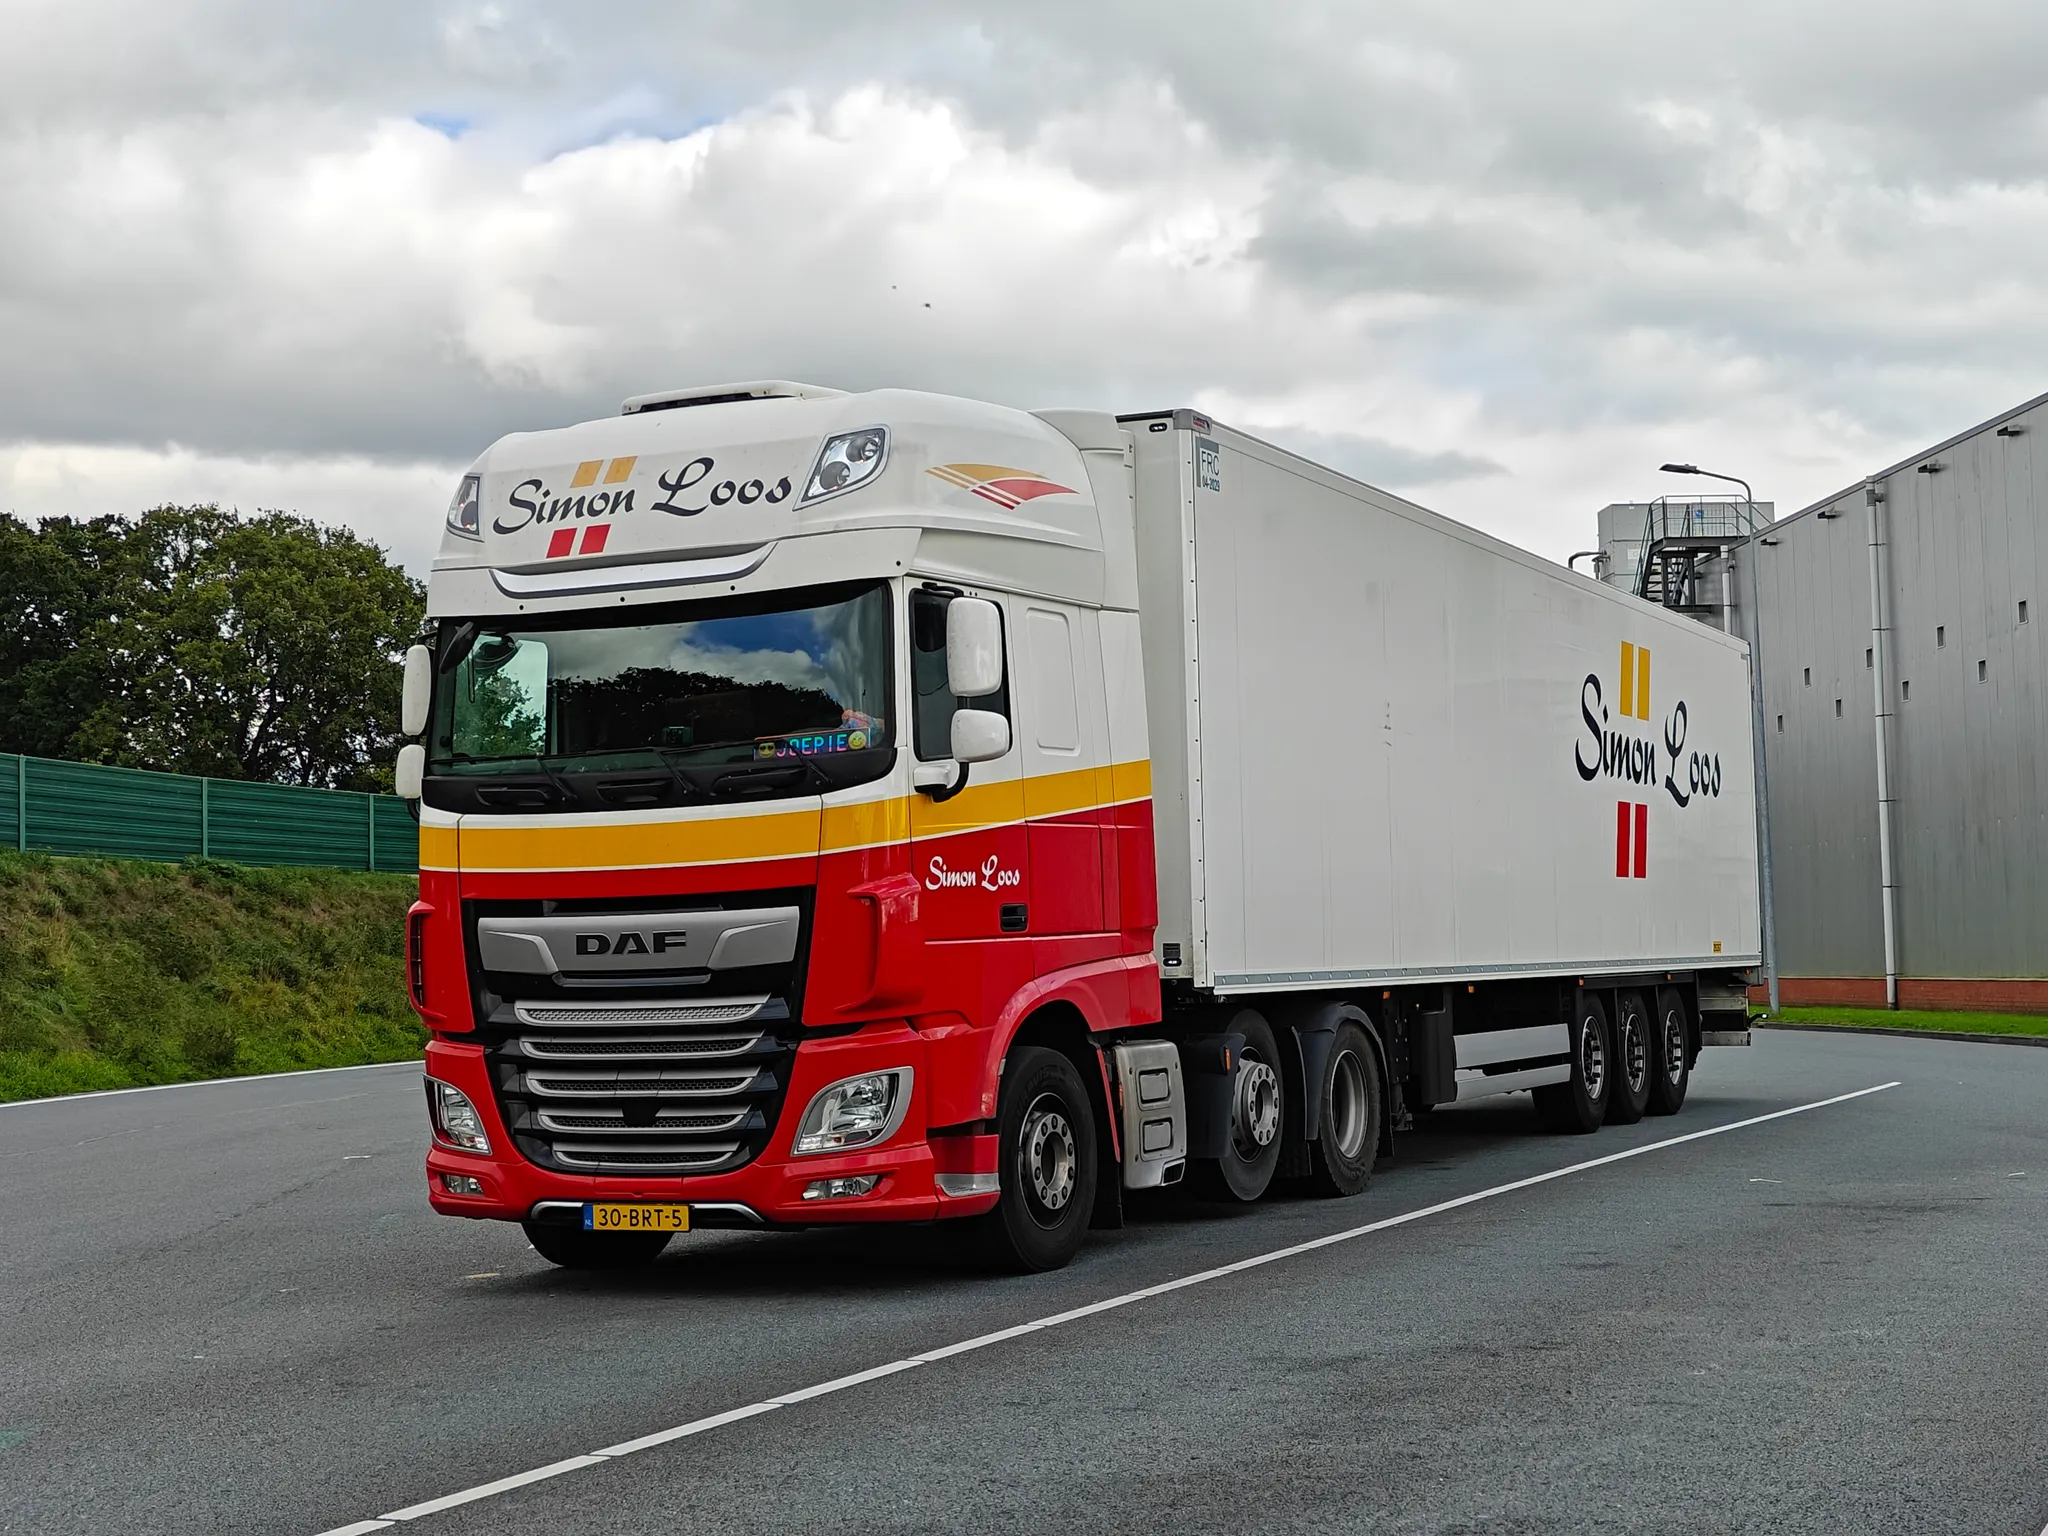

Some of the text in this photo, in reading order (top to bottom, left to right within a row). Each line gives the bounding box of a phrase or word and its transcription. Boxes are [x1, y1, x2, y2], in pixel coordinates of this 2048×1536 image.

[1201, 450, 1220, 476] FRC
[492, 456, 794, 535] Simon Loos
[1574, 673, 1722, 809] Simon Loos
[925, 854, 1021, 892] Simon Loos
[576, 929, 687, 956] DAF
[598, 1208, 683, 1228] 30-BRT-5
